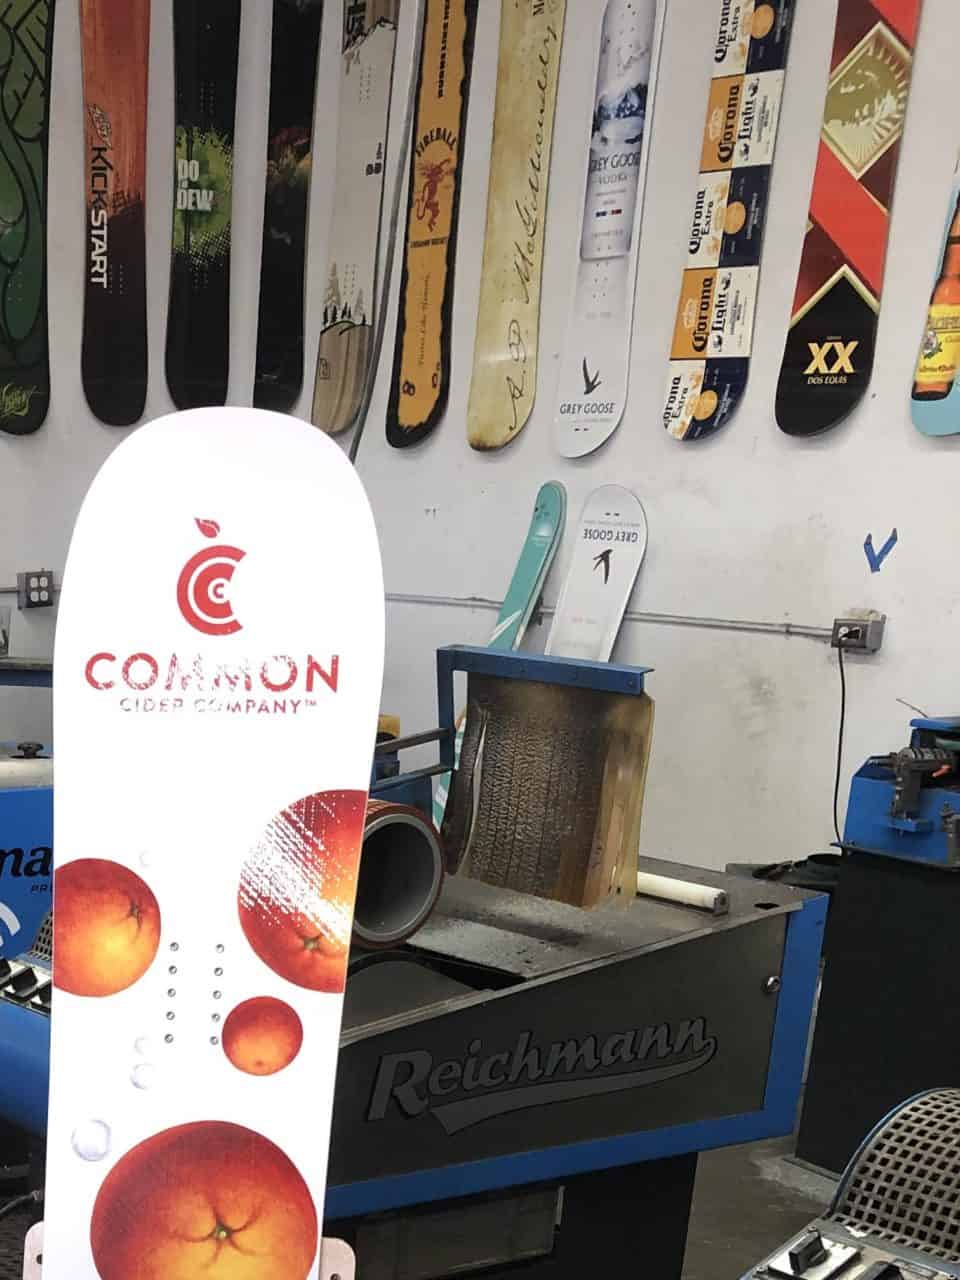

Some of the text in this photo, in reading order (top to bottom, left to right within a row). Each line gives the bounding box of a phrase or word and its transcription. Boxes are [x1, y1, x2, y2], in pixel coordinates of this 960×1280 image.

[727, 6, 741, 43] Extra
[717, 85, 740, 163] Corona
[738, 99, 756, 140] Light
[178, 160, 200, 181] DO
[91, 146, 113, 289] KICKSTART
[177, 188, 214, 211] DEW
[688, 189, 706, 255] Corona
[701, 201, 714, 236] Extra
[691, 277, 714, 352] Corona
[711, 293, 729, 334] Light
[803, 341, 859, 374] XX
[807, 376, 823, 384] DOS
[560, 403, 616, 414] GREY GOOSE
[583, 528, 638, 543] GREY GOOSE
[367, 1015, 718, 1121] Reichmann
